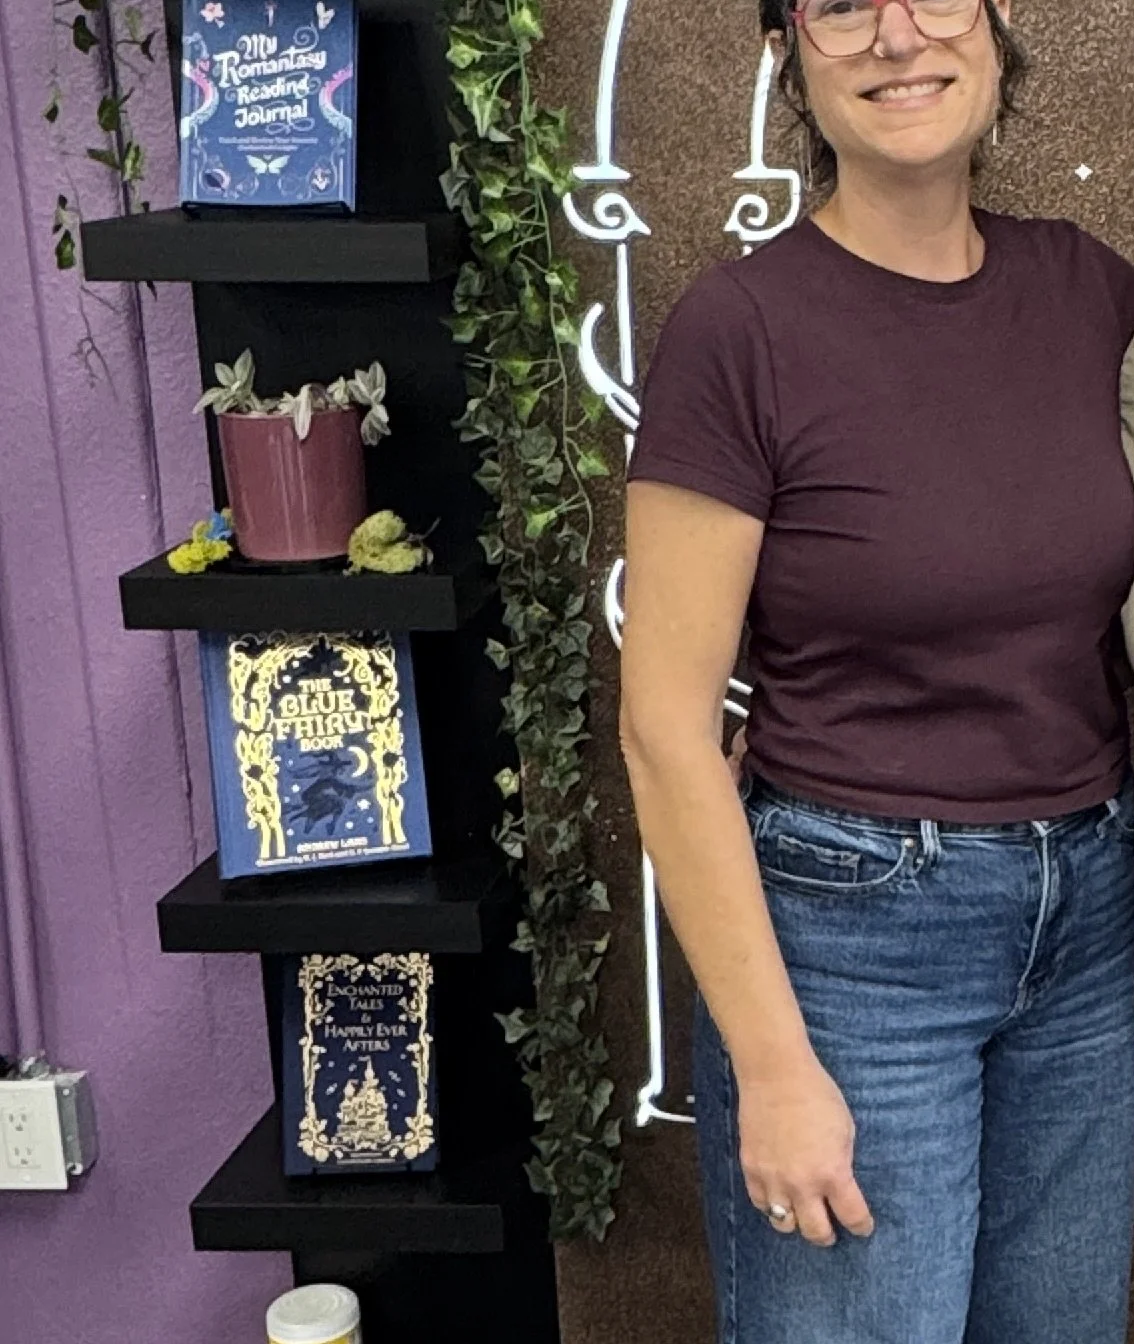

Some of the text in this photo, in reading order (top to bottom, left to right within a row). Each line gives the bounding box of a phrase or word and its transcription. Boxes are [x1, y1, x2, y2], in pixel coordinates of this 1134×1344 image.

[212, 42, 328, 88] Romantasy
[236, 73, 311, 106] Reading
[234, 98, 308, 128] Journal
[298, 677, 333, 694] THE
[279, 688, 357, 718] BLUE
[273, 710, 374, 741] FAIRY
[300, 734, 344, 753] BOOK
[326, 983, 404, 998] ENCHANTED
[349, 997, 385, 1011] TALES
[324, 1023, 408, 1038] HAPPILY EVER
[342, 1038, 391, 1052] AFTERS
